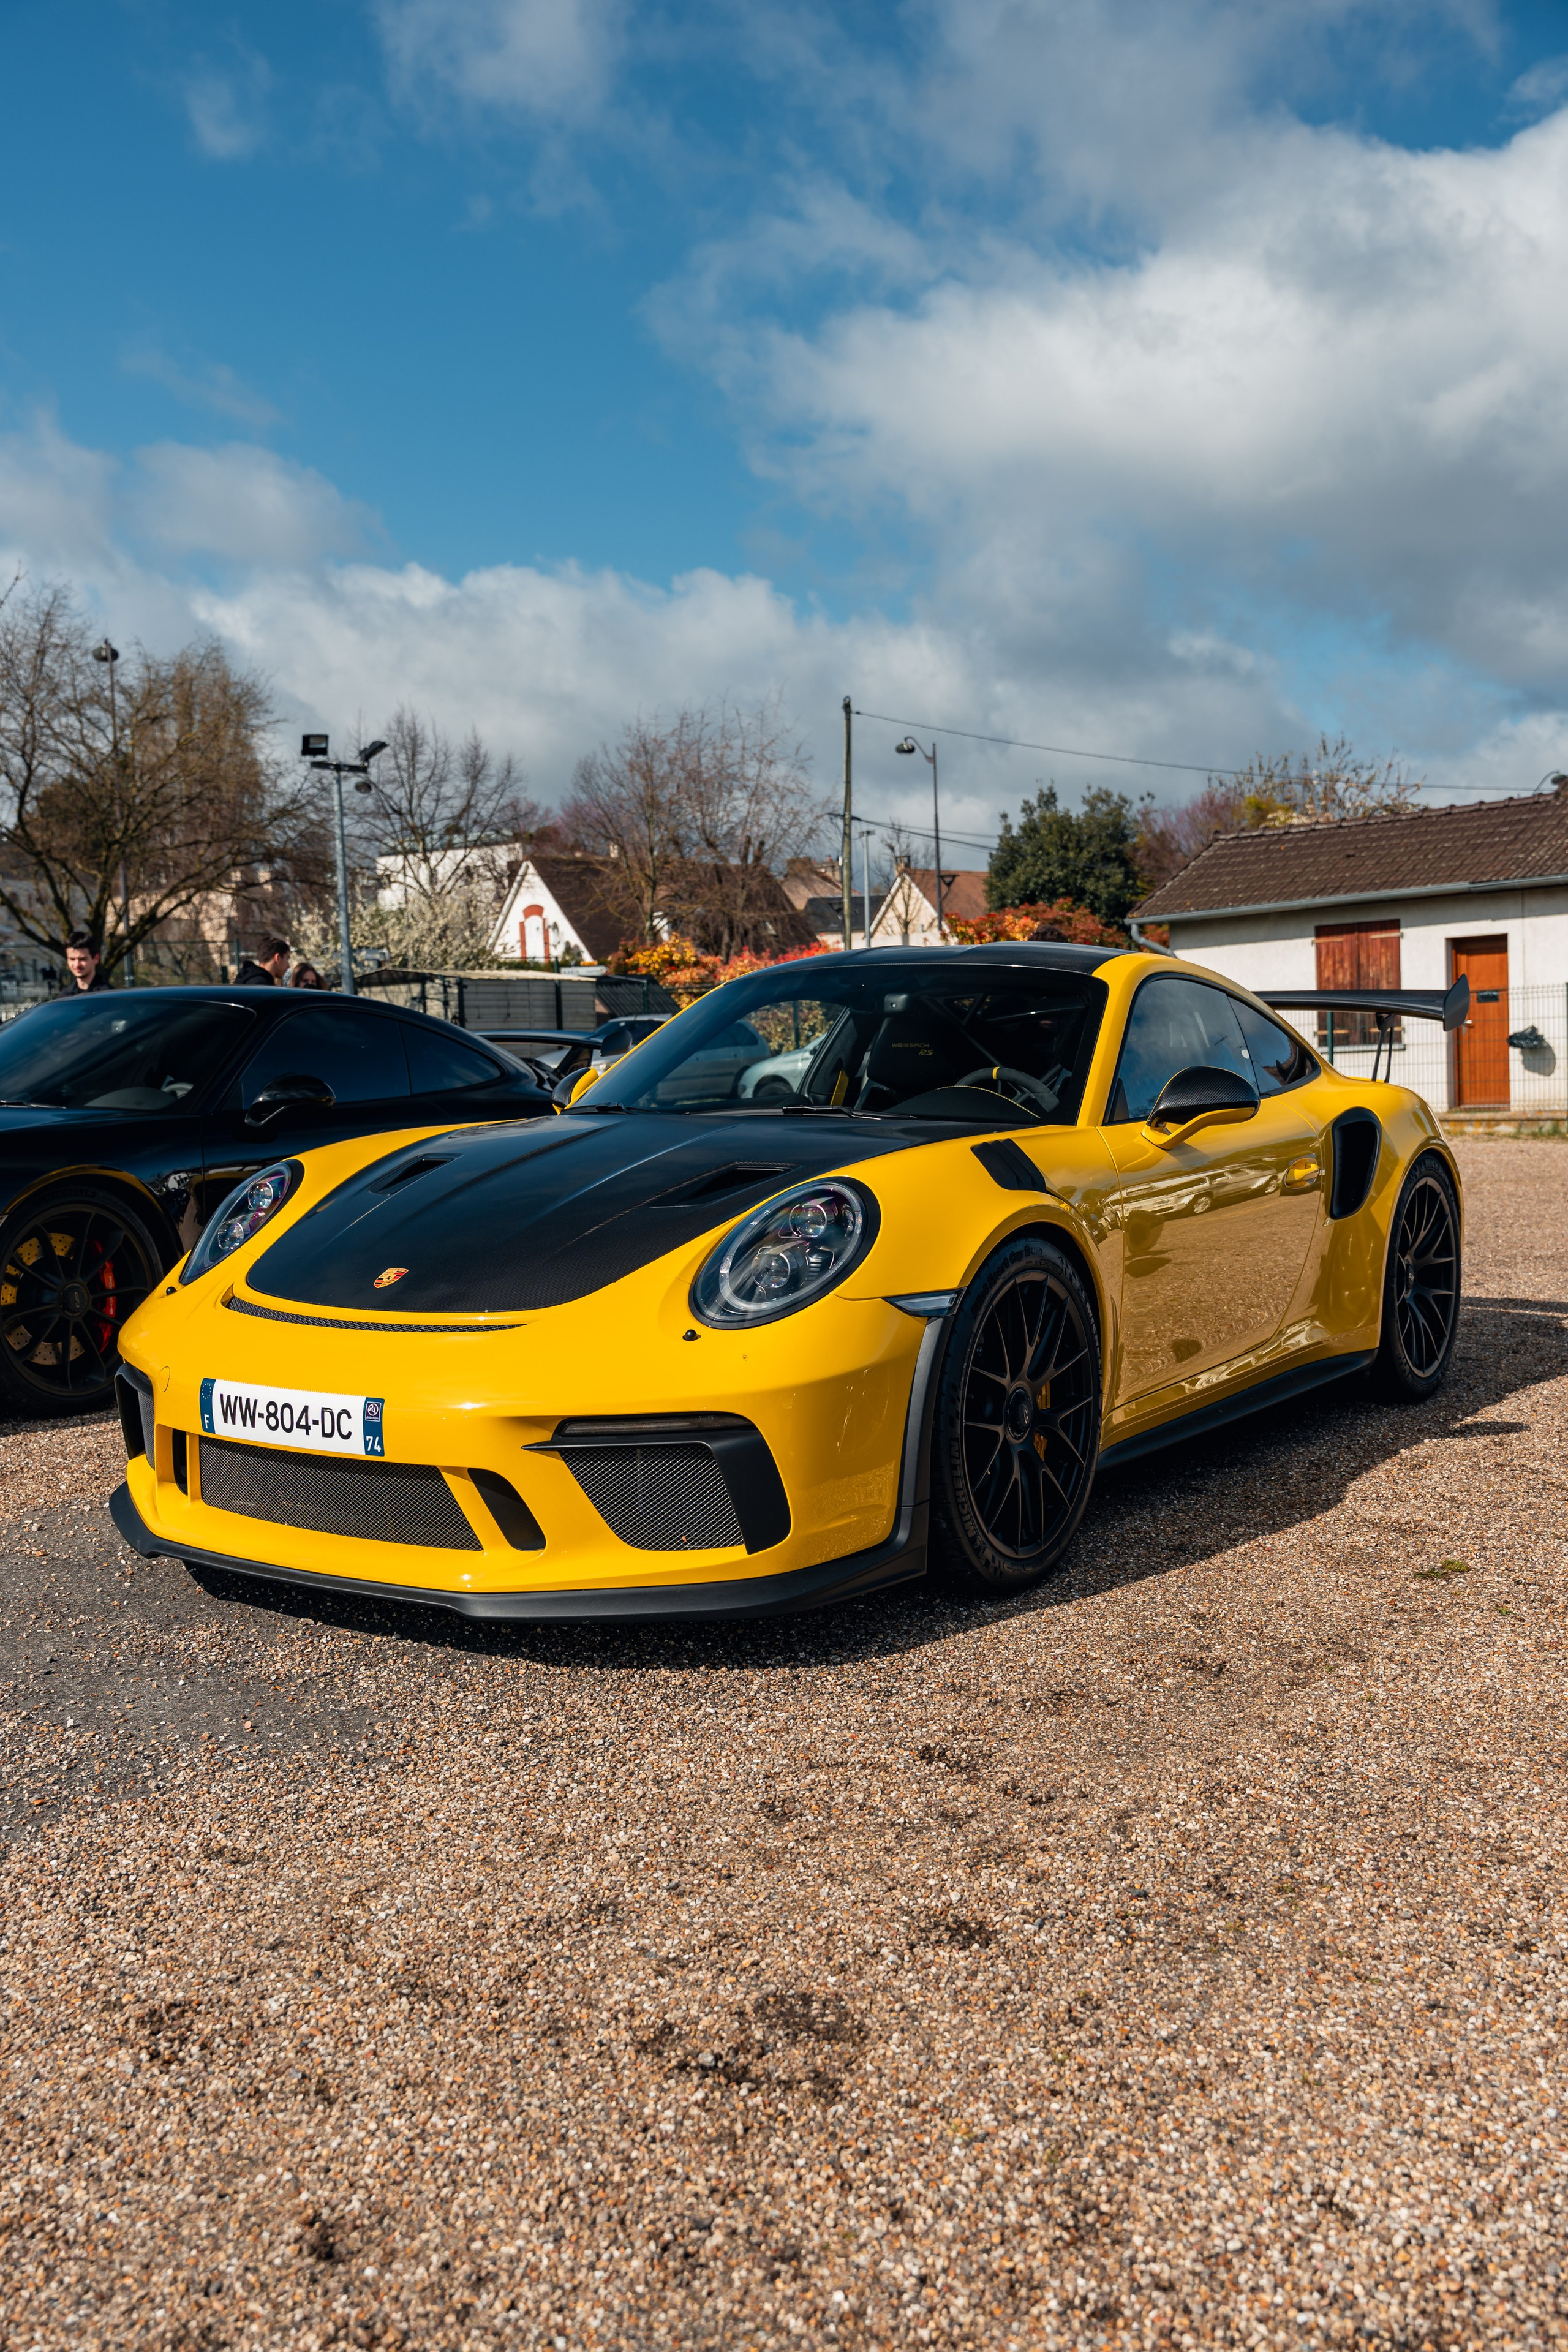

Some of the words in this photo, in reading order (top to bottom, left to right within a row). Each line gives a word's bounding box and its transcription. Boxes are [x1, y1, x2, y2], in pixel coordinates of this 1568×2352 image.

[1009, 1251, 1023, 1264] Cup
[1024, 1245, 1030, 1257] 2
[204, 1414, 209, 1429] F
[220, 1393, 352, 1440] WW-804-DC
[366, 1436, 382, 1452] 74
[949, 1436, 977, 1538] MICHELIN
